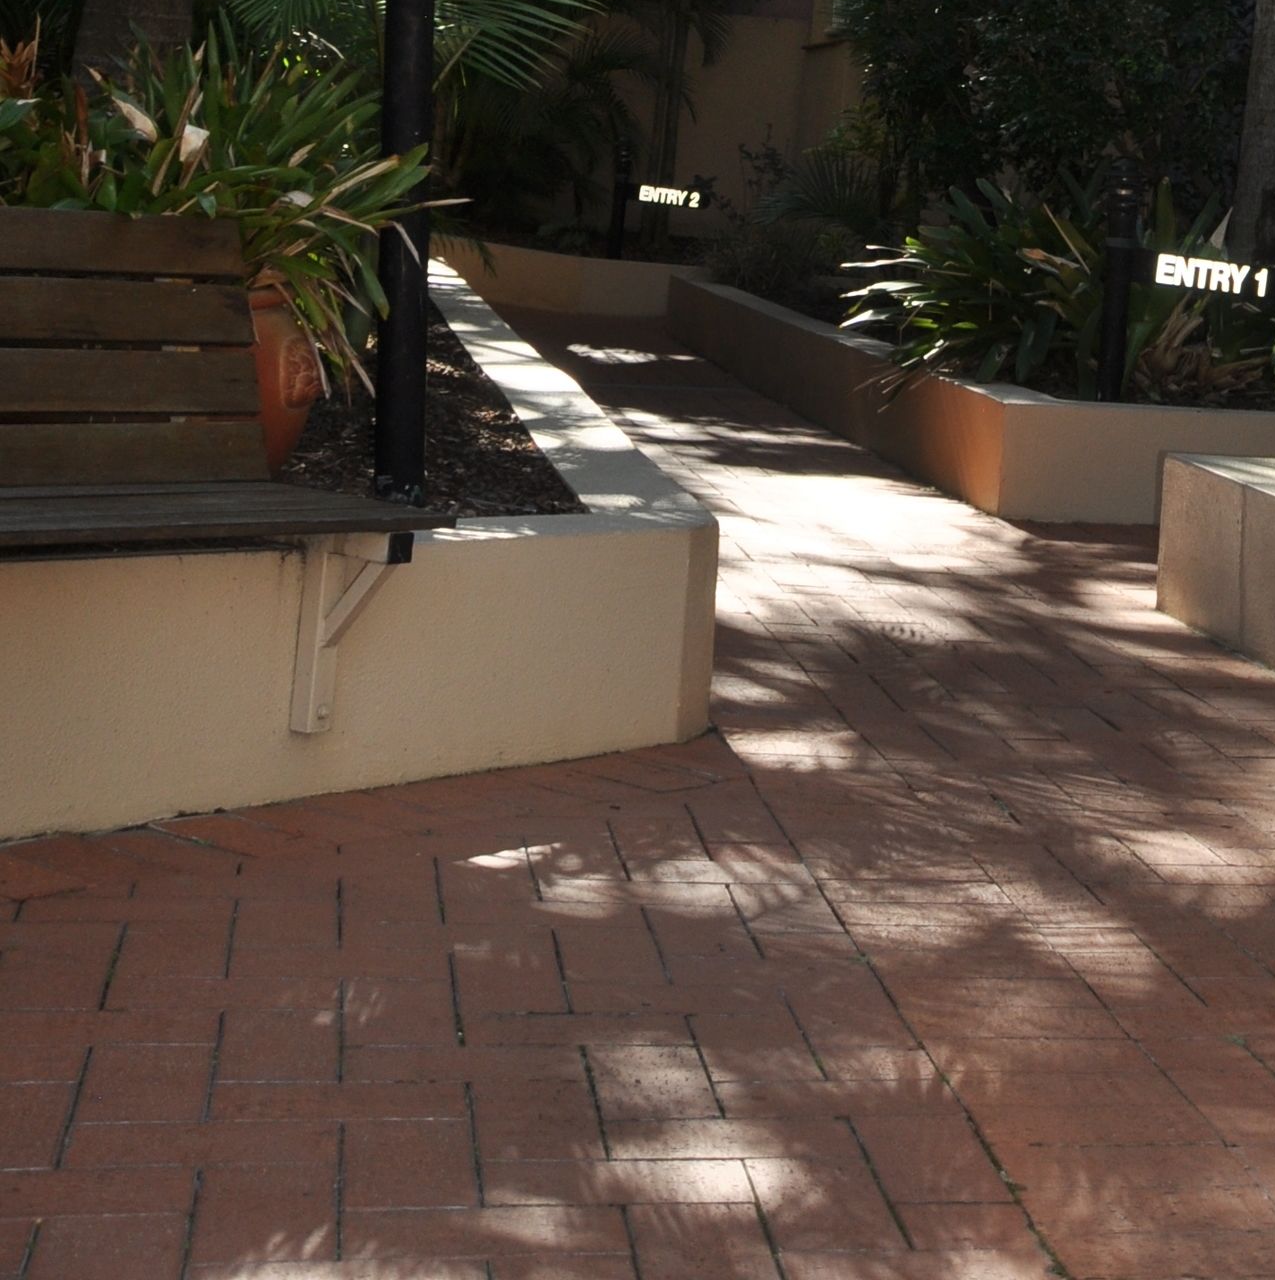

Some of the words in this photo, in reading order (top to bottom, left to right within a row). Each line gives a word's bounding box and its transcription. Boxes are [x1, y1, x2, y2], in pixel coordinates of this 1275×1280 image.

[639, 185, 688, 206] ENTRY
[688, 191, 700, 208] 2
[1155, 253, 1251, 294] ENTRY
[1254, 267, 1269, 298] 1
